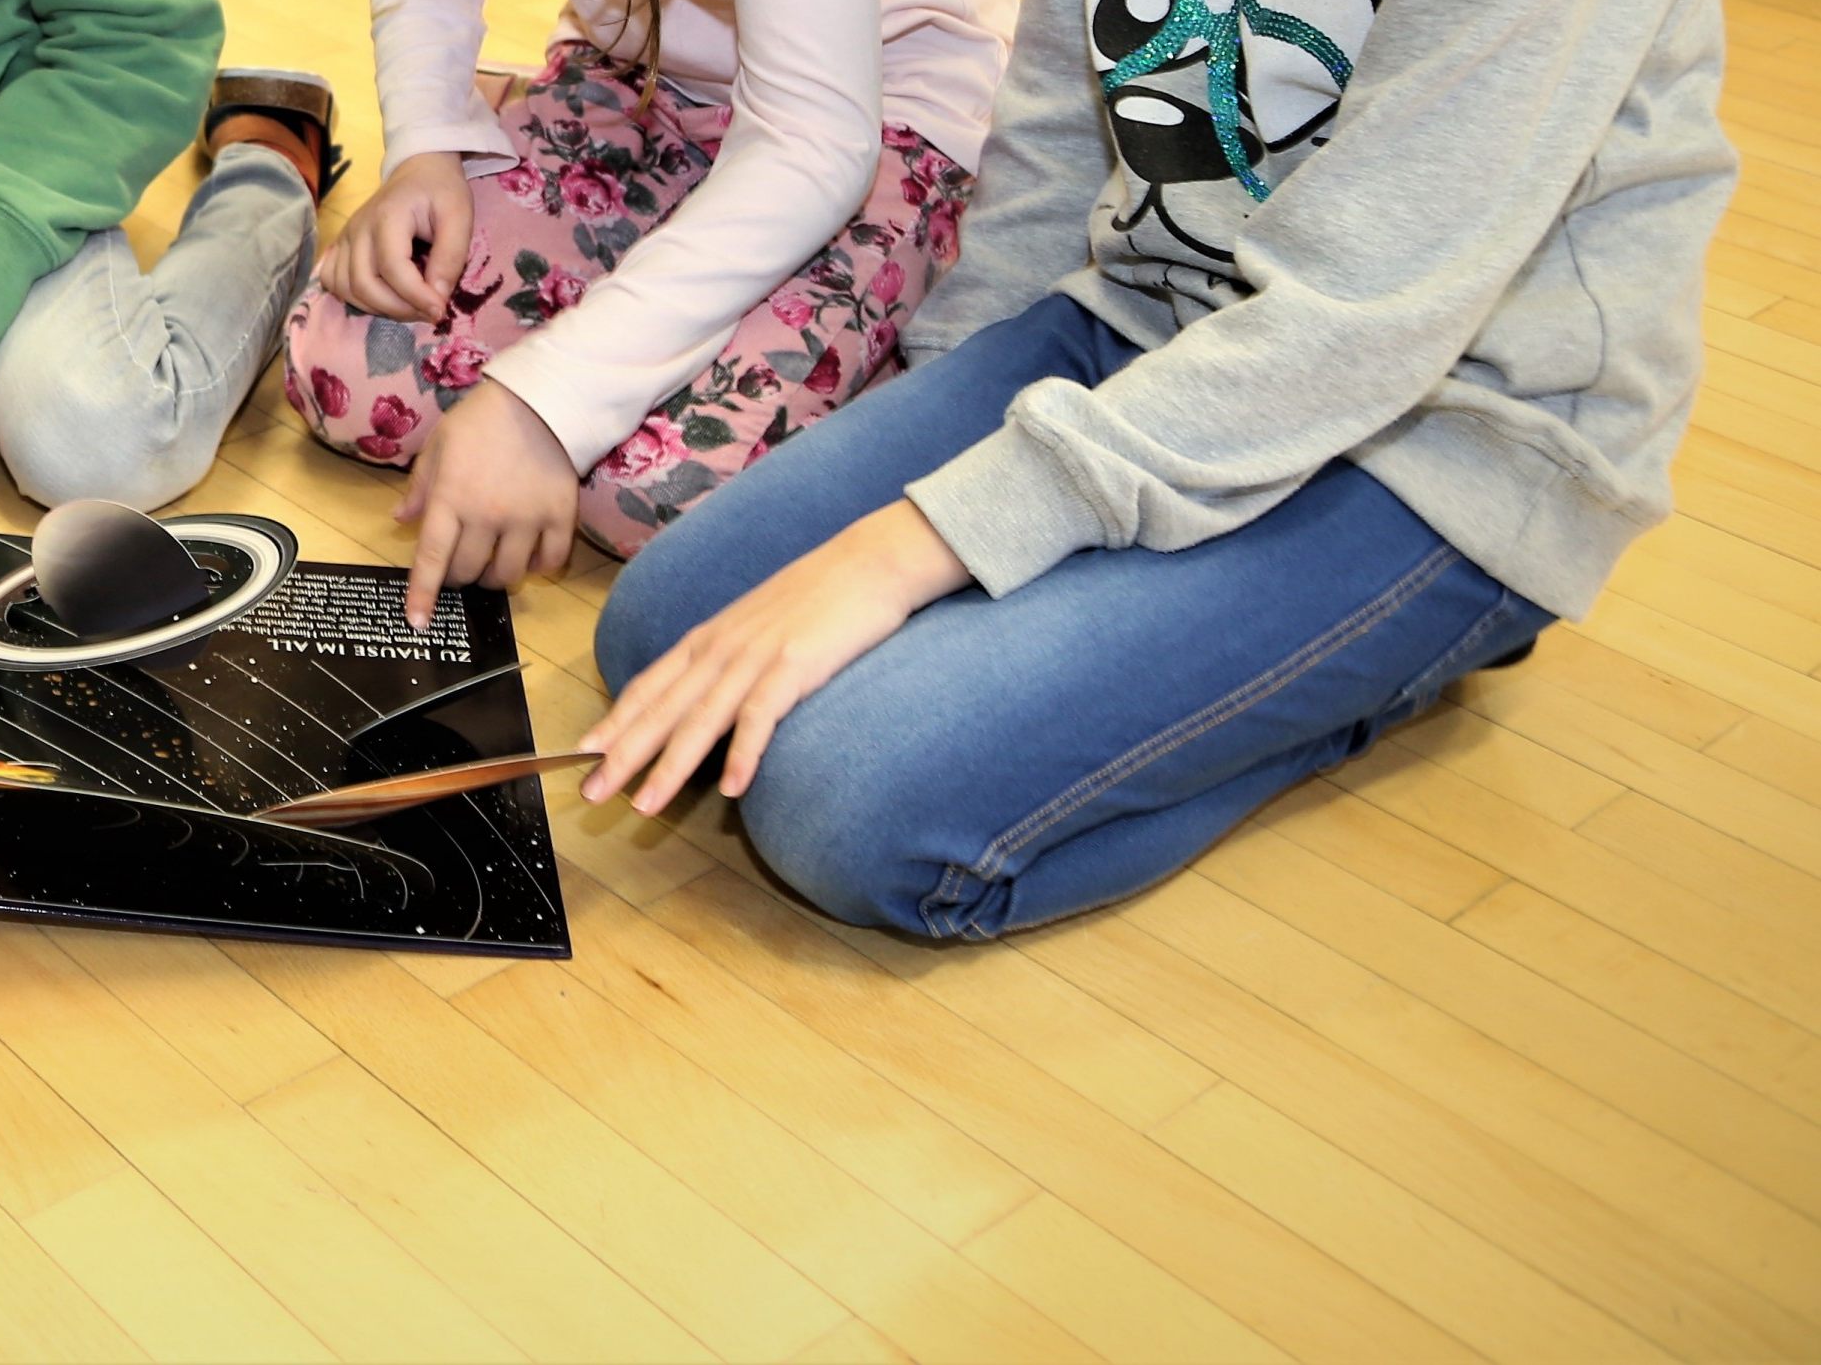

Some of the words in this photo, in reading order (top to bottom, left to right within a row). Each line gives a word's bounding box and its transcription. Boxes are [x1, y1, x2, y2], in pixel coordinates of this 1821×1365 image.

[273, 628, 317, 638] Himmel
[339, 625, 385, 635] Tausende
[346, 633, 392, 644] Nächten
[394, 636, 430, 645] klaren
[447, 639, 470, 648] Wer
[267, 638, 309, 652] ALL
[316, 642, 345, 655] IM
[354, 644, 431, 661] HAUSE
[440, 649, 471, 663] ZU
